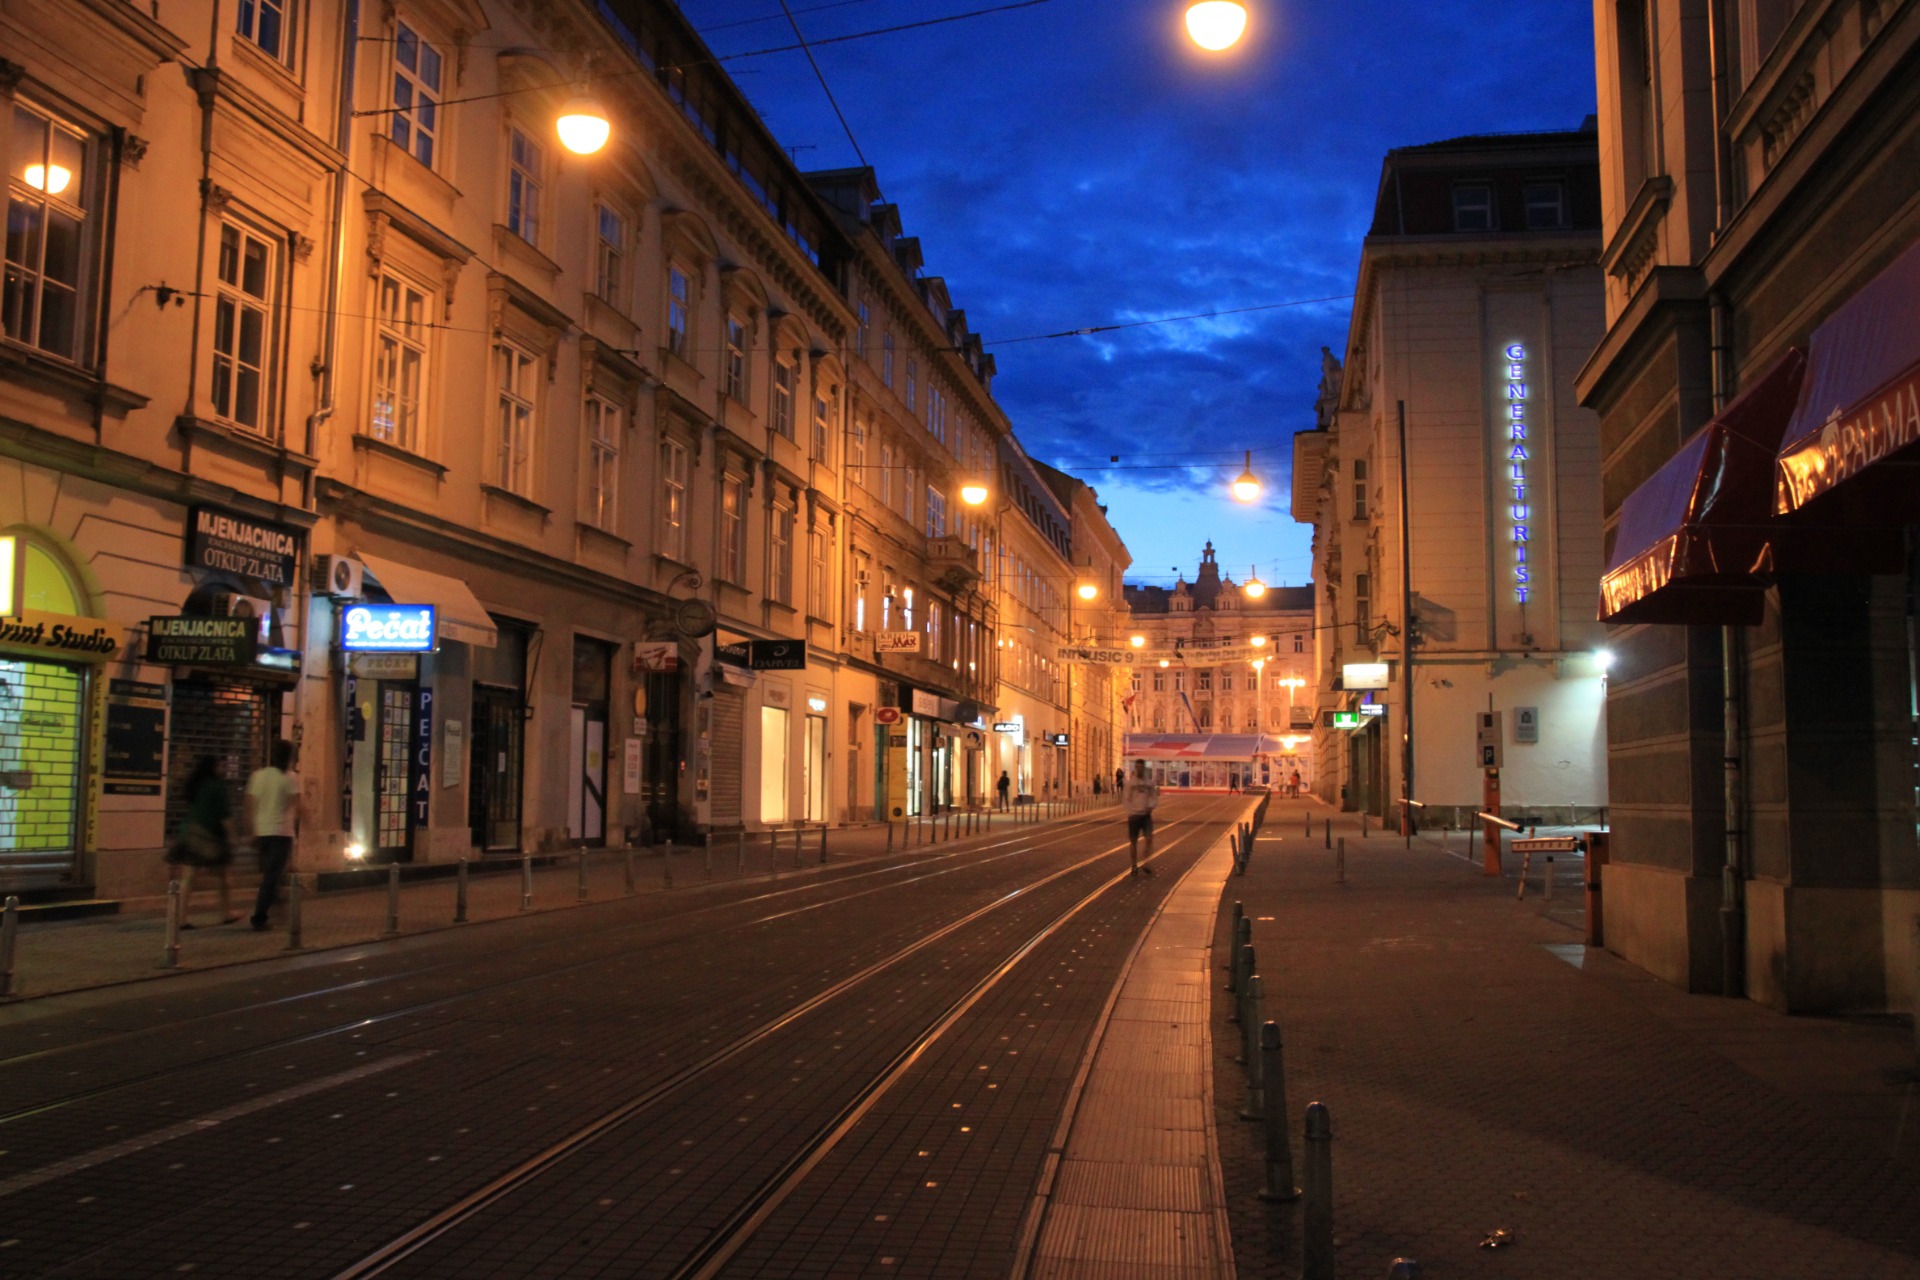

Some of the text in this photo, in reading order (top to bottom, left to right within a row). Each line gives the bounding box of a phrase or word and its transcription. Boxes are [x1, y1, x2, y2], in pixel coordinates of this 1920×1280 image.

[1842, 382, 1920, 479] PALMA
[1505, 343, 1528, 603] GENERALTURIST
[204, 548, 284, 583] OTKUP ZLATA
[45, 624, 116, 653] Studio
[345, 607, 431, 640] Pečat
[157, 645, 236, 661] OTKUP ZLATA
[1125, 652, 1134, 663] 9
[416, 692, 432, 819] PEČAT
